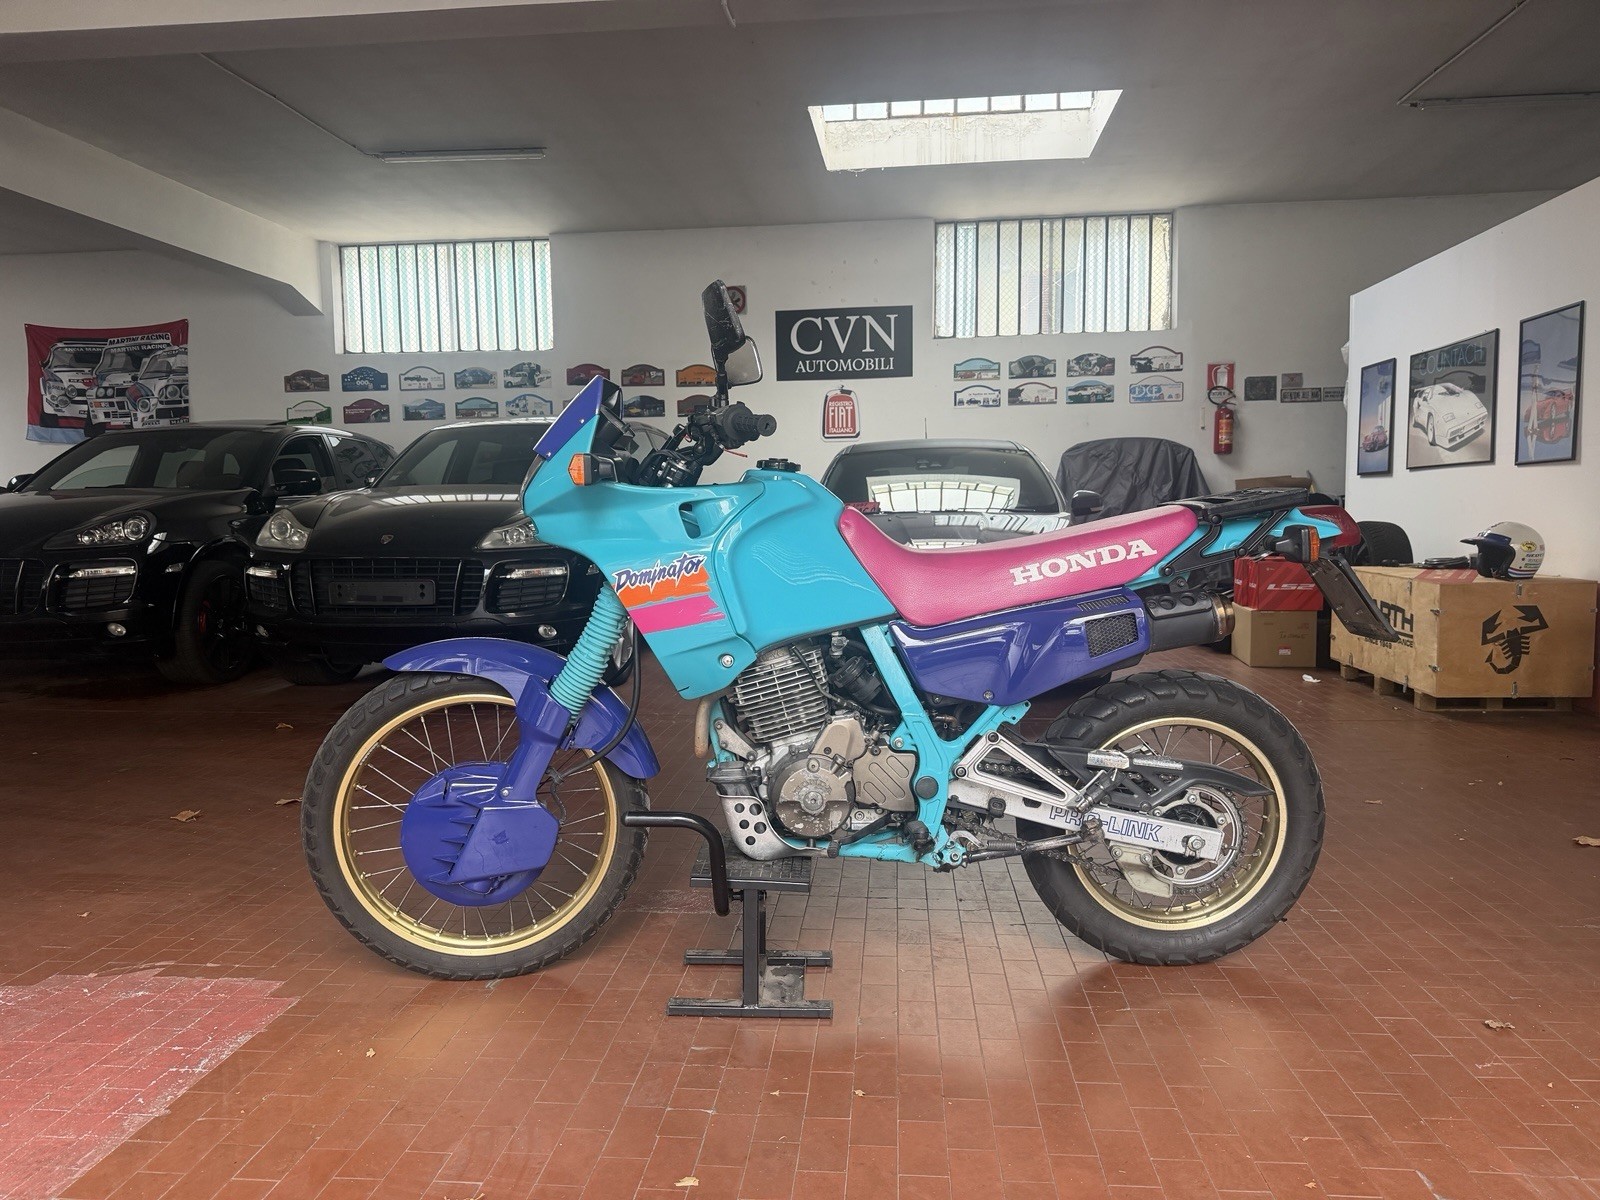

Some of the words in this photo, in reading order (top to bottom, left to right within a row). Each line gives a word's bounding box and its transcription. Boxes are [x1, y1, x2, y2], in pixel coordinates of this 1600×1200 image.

[108, 336, 139, 346] MARTINI
[140, 333, 170, 342] RACING
[790, 314, 899, 355] CVN
[110, 345, 140, 353] MARTINI
[1419, 342, 1484, 376] COUNTACH
[795, 357, 894, 373] AUTOMOBILI
[829, 406, 853, 428] FIAT
[613, 553, 706, 593] Dominator
[1008, 538, 1158, 586] HONDA
[1373, 599, 1414, 632] RTH
[1397, 638, 1414, 648] ANCE
